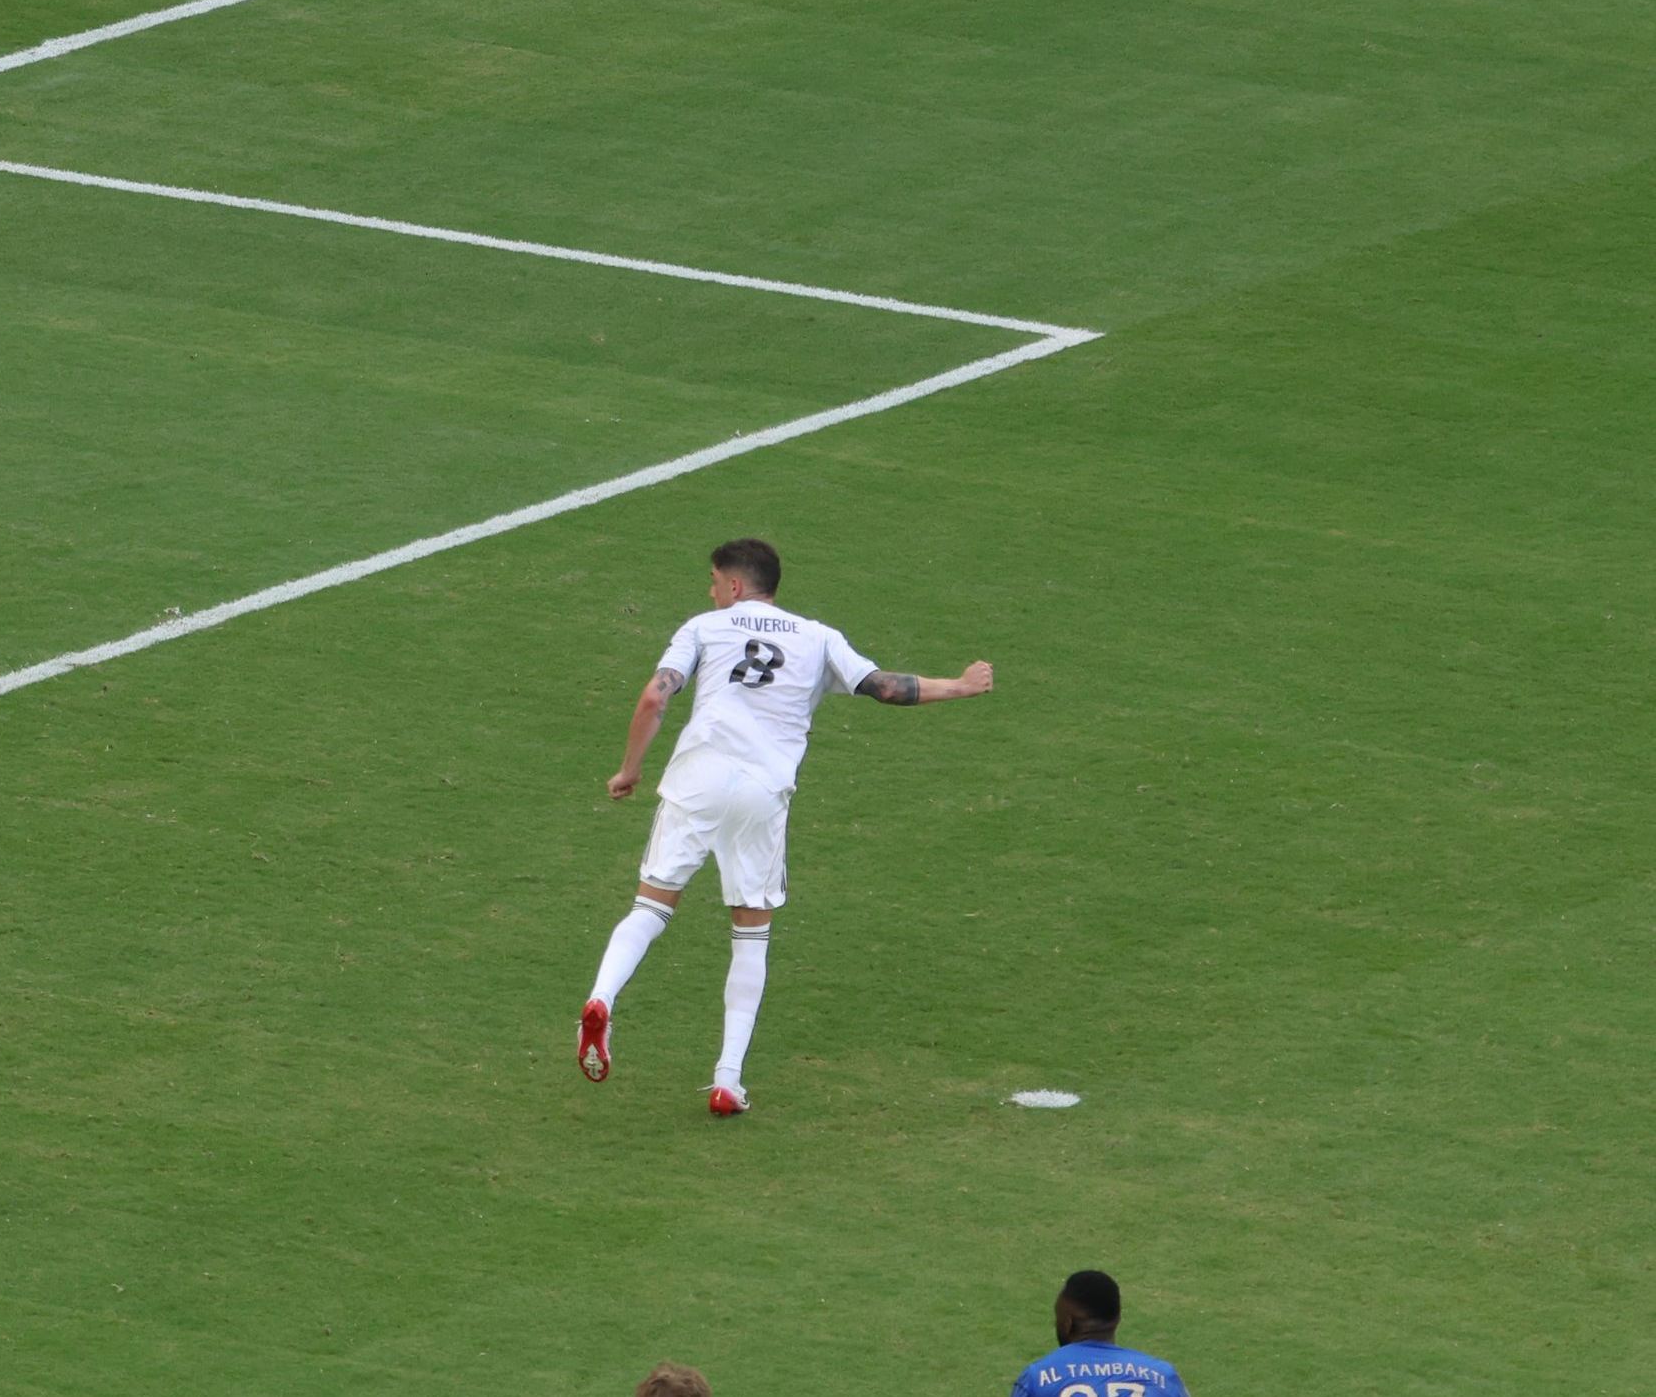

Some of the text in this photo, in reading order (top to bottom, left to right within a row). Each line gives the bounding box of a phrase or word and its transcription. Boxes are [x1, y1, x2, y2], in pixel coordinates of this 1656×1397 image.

[731, 616, 801, 635] VALVERDE
[728, 637, 786, 689] 8
[1039, 1366, 1063, 1388] AL
[1067, 1362, 1167, 1390] TAMBAKTI
